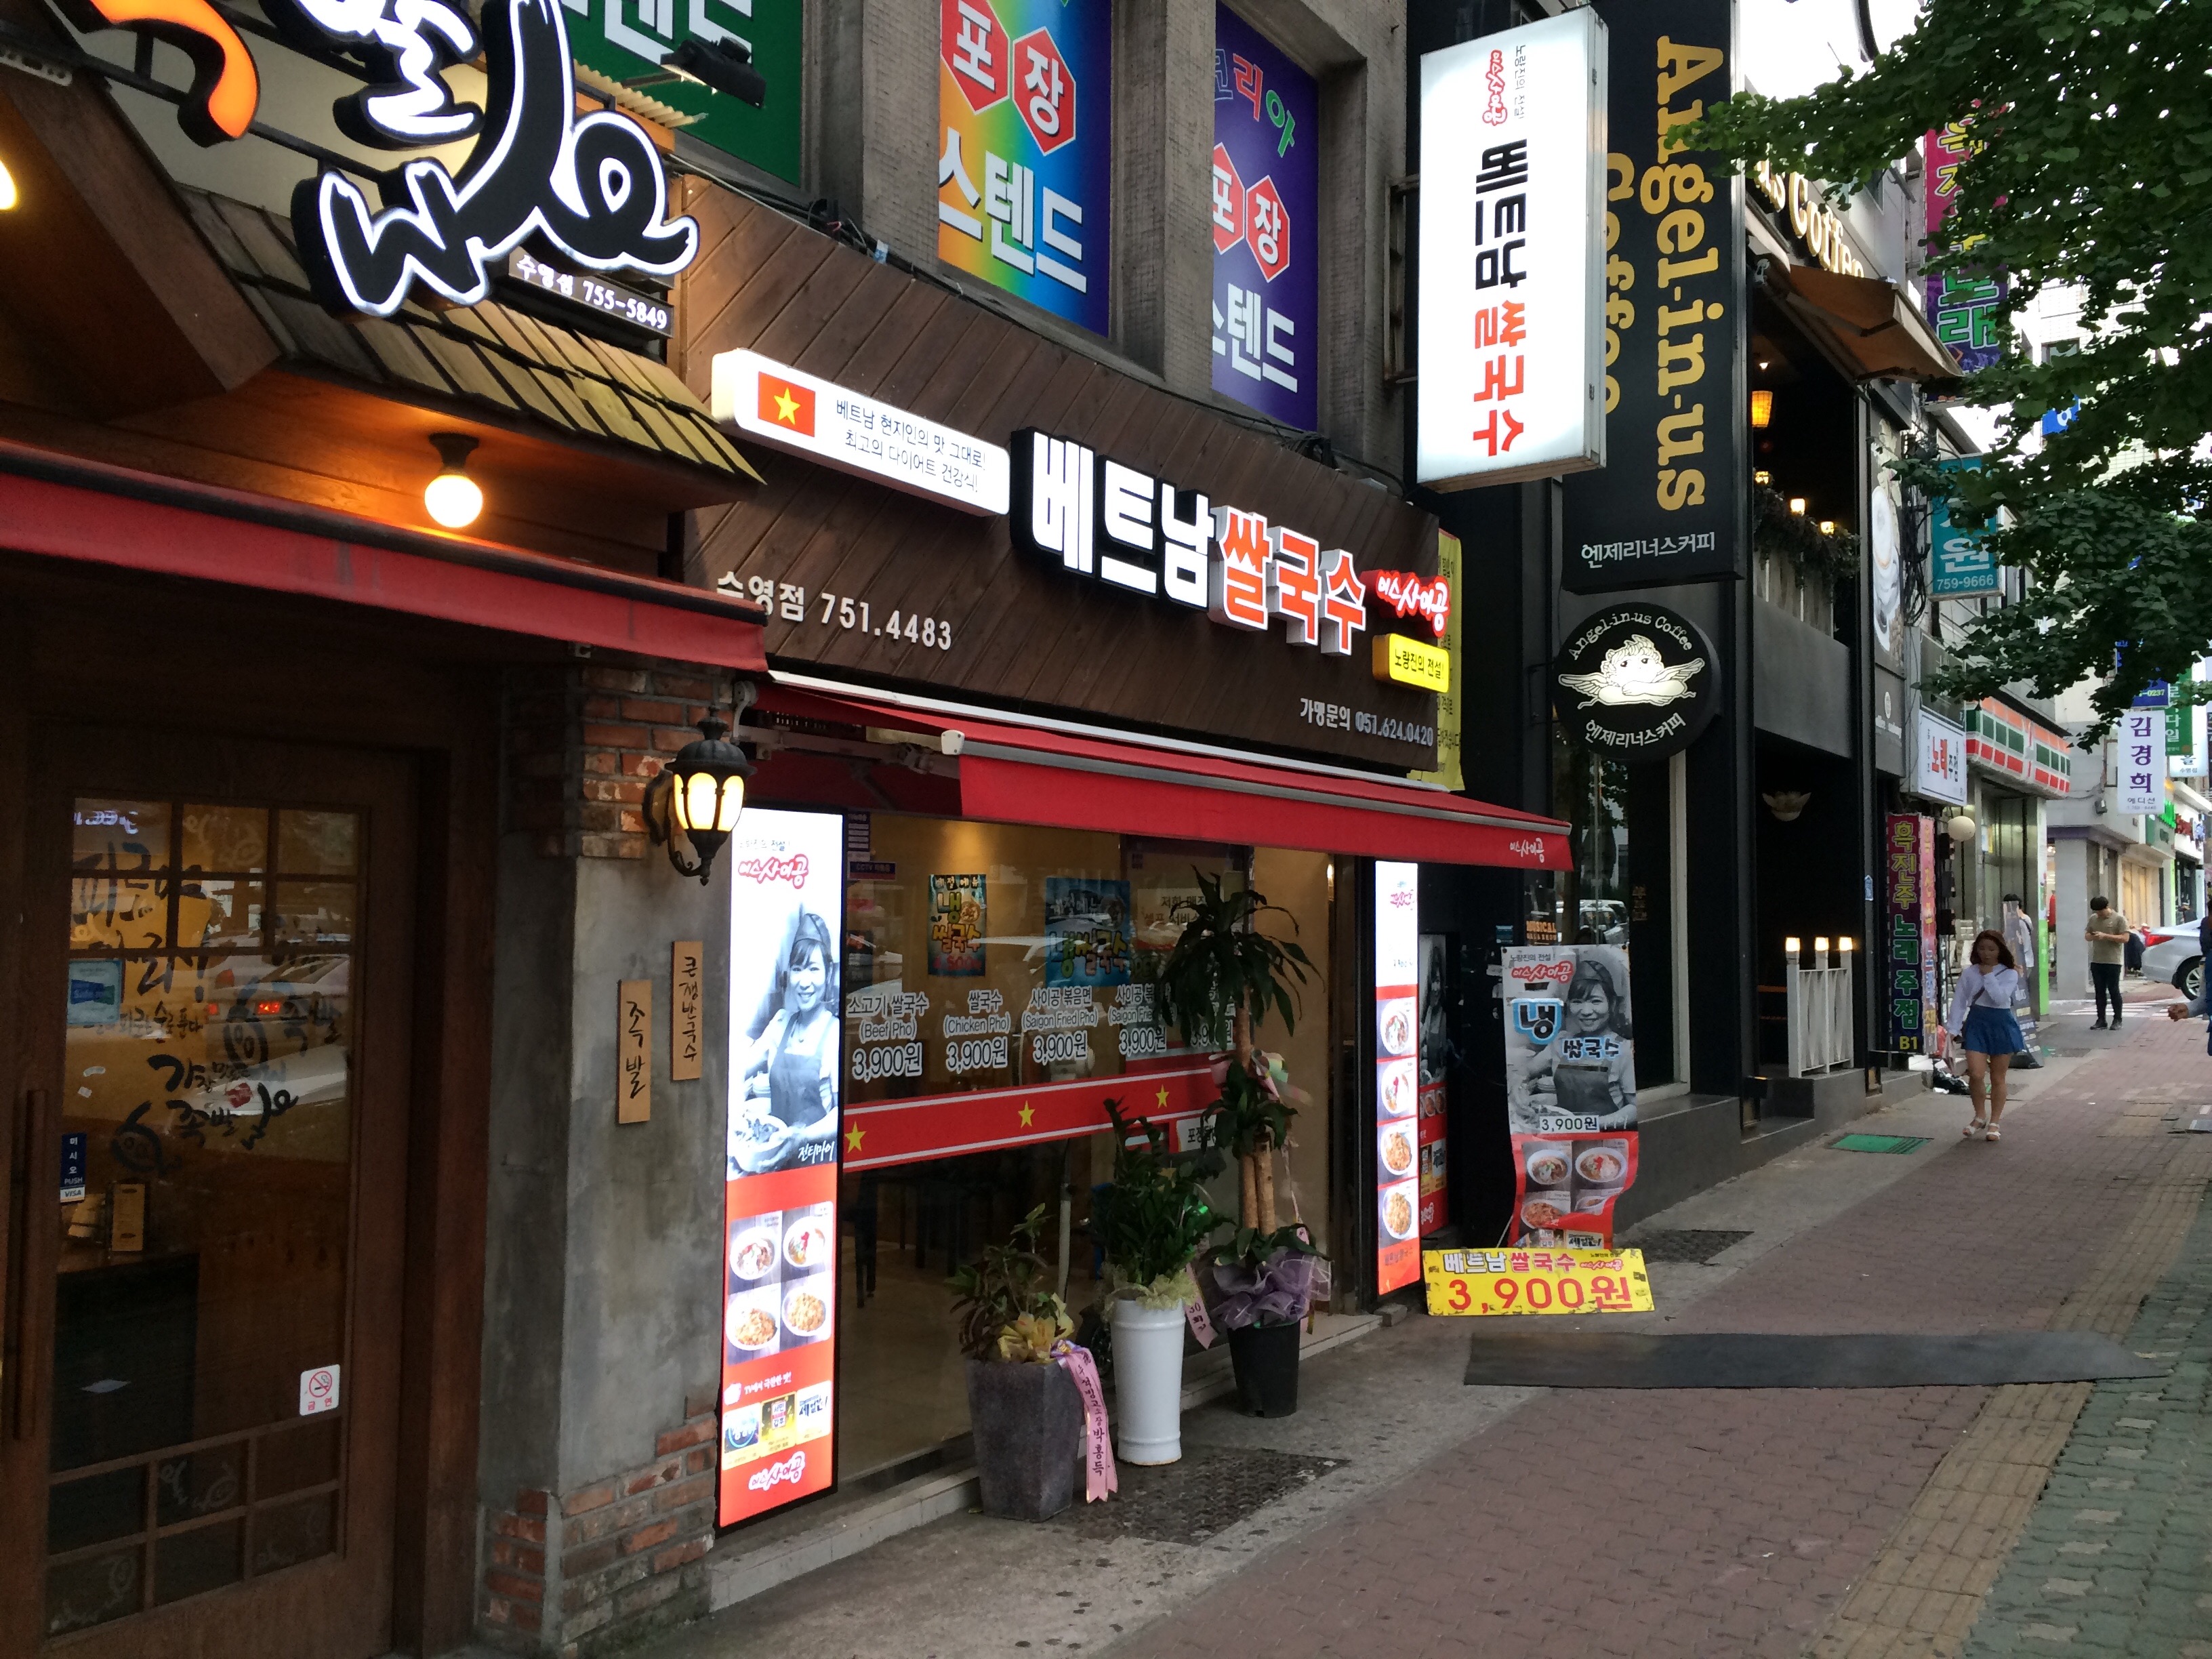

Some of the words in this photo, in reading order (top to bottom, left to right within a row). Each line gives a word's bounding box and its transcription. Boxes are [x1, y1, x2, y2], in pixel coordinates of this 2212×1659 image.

[953, 2, 1063, 136] 포장
[1515, 45, 1525, 89] 노량진의
[939, 127, 1086, 293] 스텐드
[1475, 138, 1528, 290] 베트남
[583, 280, 667, 329] 755-5849
[1473, 300, 1526, 457] 쌀국수
[836, 399, 875, 430] 베트남
[881, 415, 928, 446] 현지인의
[934, 435, 945, 455] 맛
[949, 441, 987, 471] 그대로!
[845, 430, 882, 456] 최고의
[888, 445, 936, 476] 다이어트
[941, 466, 979, 493] 건강식!
[1032, 431, 1214, 609] 베트남
[1219, 505, 1366, 655] 쌀국수
[1581, 531, 1716, 569] 엔제리너스커피
[1936, 574, 1994, 591] 759-9666
[821, 593, 951, 651] 751.4483
[1568, 612, 1652, 660] Angel-in-us
[1655, 616, 1693, 651] Coffee
[1395, 649, 1425, 674] 노량진의
[1300, 698, 1351, 731] 가맹문의
[1355, 711, 1434, 747] 051.624.0420
[1586, 712, 1686, 748] 엔제리너스커피
[2130, 716, 2153, 794] 김경희
[1891, 821, 1917, 910] 흑진주
[937, 891, 962, 924] 냉
[933, 922, 982, 954] 쌀국수
[1511, 953, 1536, 962] 노량진의
[847, 994, 887, 1017] 소고기
[890, 991, 929, 1017] 쌀국수
[968, 989, 1003, 1013] 쌀국수
[1030, 987, 1061, 1009] 사이공
[1063, 985, 1092, 1007] 볶음면
[1115, 983, 1144, 1006] 사이공
[859, 1020, 890, 1043] (Beef
[892, 1018, 917, 1040] Pho)
[943, 1015, 987, 1038] (Chicken
[988, 1012, 1010, 1034] Pho)
[1022, 1010, 1056, 1031] (Saigon
[1057, 1009, 1078, 1028] Fried
[1079, 1006, 1099, 1027] Pho)
[1138, 1005, 1153, 1023] Frie
[1519, 1002, 1557, 1040] 냉
[624, 1000, 647, 1100] 족발
[946, 1036, 1008, 1074] 3,900원
[1033, 1030, 1088, 1065] 3,900원
[1119, 1025, 1167, 1057] 3,900원
[1561, 1038, 1621, 1060] 쌀국수
[1899, 1035, 1918, 1050] B1
[852, 1042, 923, 1083] 3,900원
[1541, 1116, 1598, 1132] 3,900원
[64, 1176, 83, 1185] PUSH
[65, 1189, 81, 1198] VISA
[1443, 1252, 1507, 1274] 베트남
[1510, 1251, 1576, 1273] 쌀국수
[1448, 1275, 1633, 1314] 3,900원
